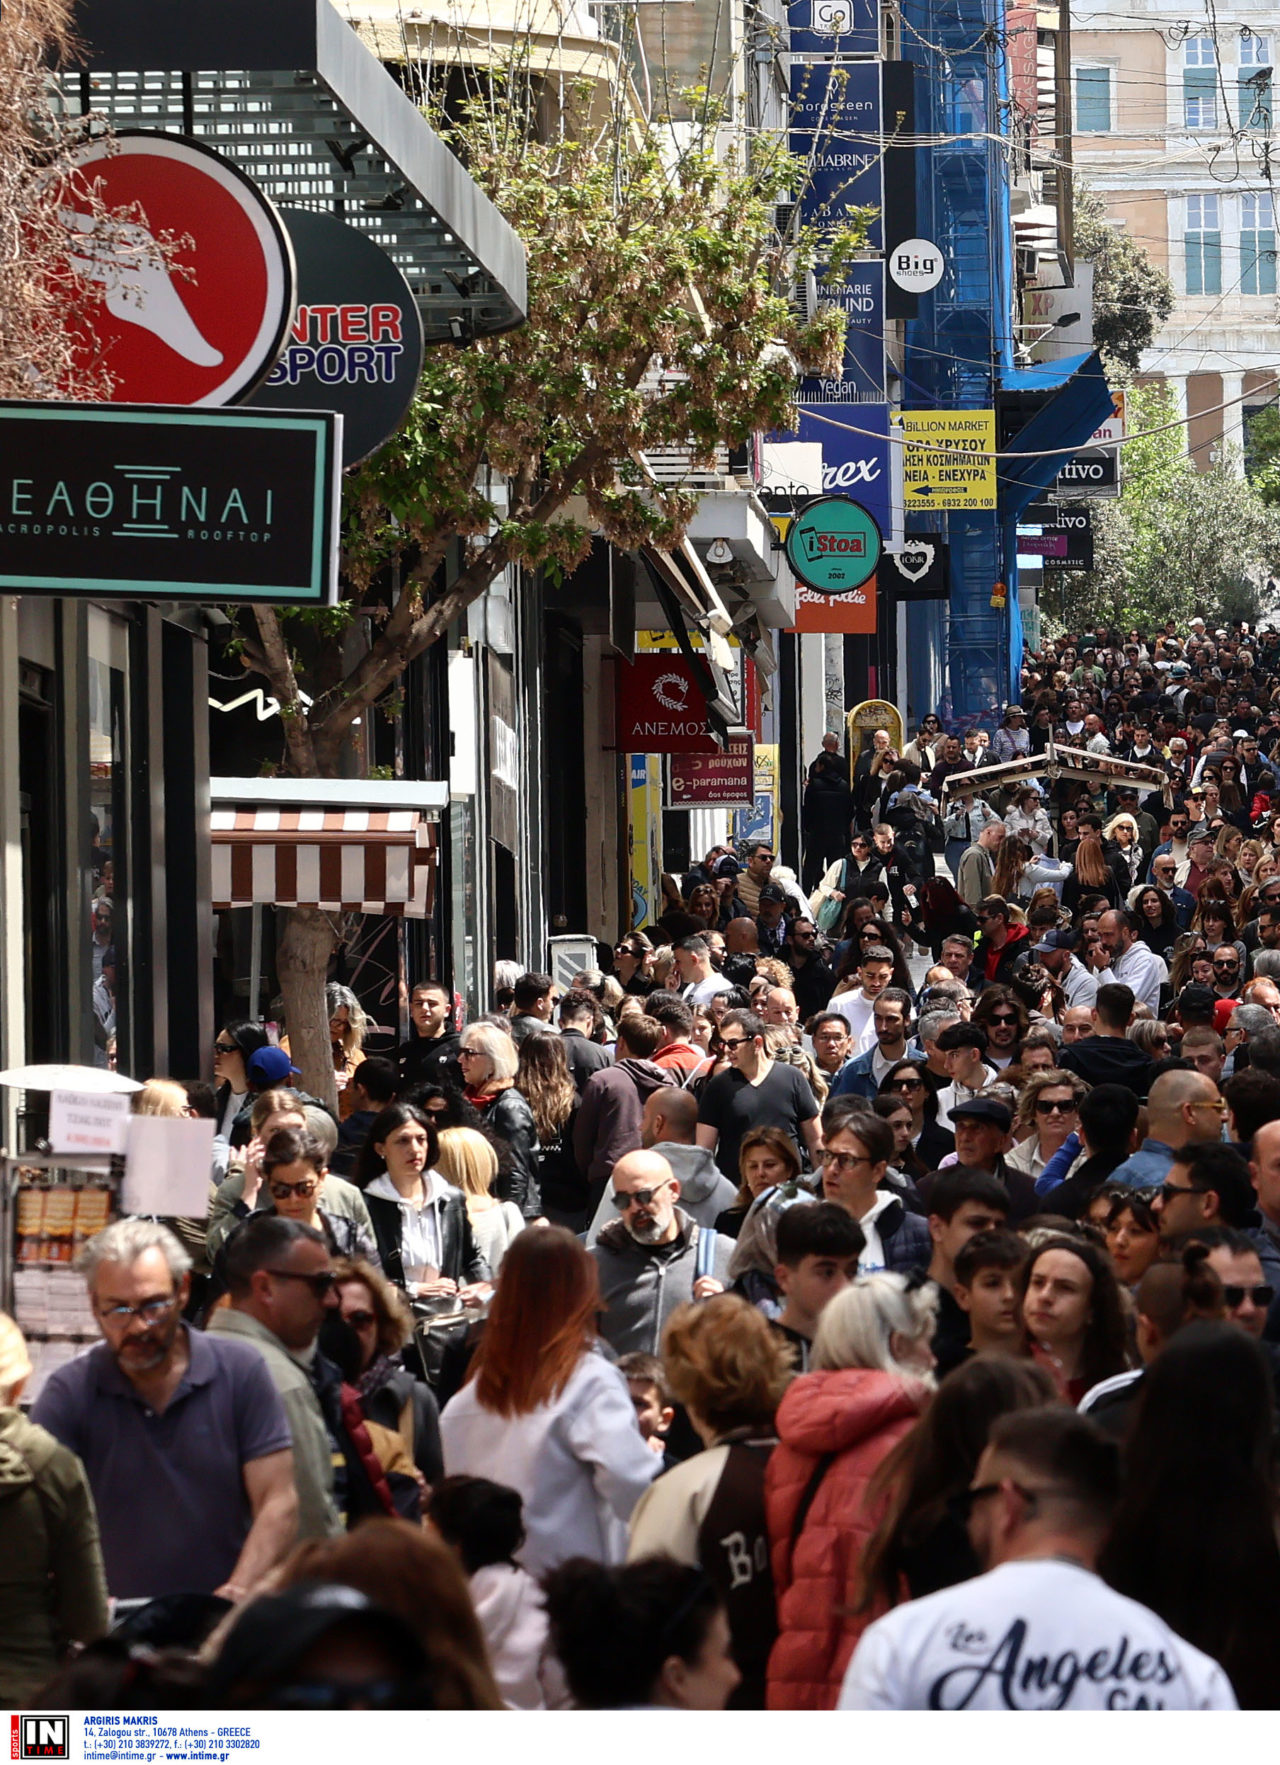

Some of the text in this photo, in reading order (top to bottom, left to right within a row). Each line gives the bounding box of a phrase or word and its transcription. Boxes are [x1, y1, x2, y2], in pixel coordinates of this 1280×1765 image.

[898, 255, 935, 275] Big
[819, 378, 857, 399] Vegan
[948, 421, 990, 432] MARKET
[903, 454, 924, 467] ΗΣΗ
[904, 469, 930, 482] ΝΕΙΑ
[938, 468, 987, 481] ΕΝΕΧΥΡΑ
[187, 529, 272, 543] ROOFTOP
[672, 775, 748, 792] e-paramana
[927, 1617, 1178, 1711] Angeles
